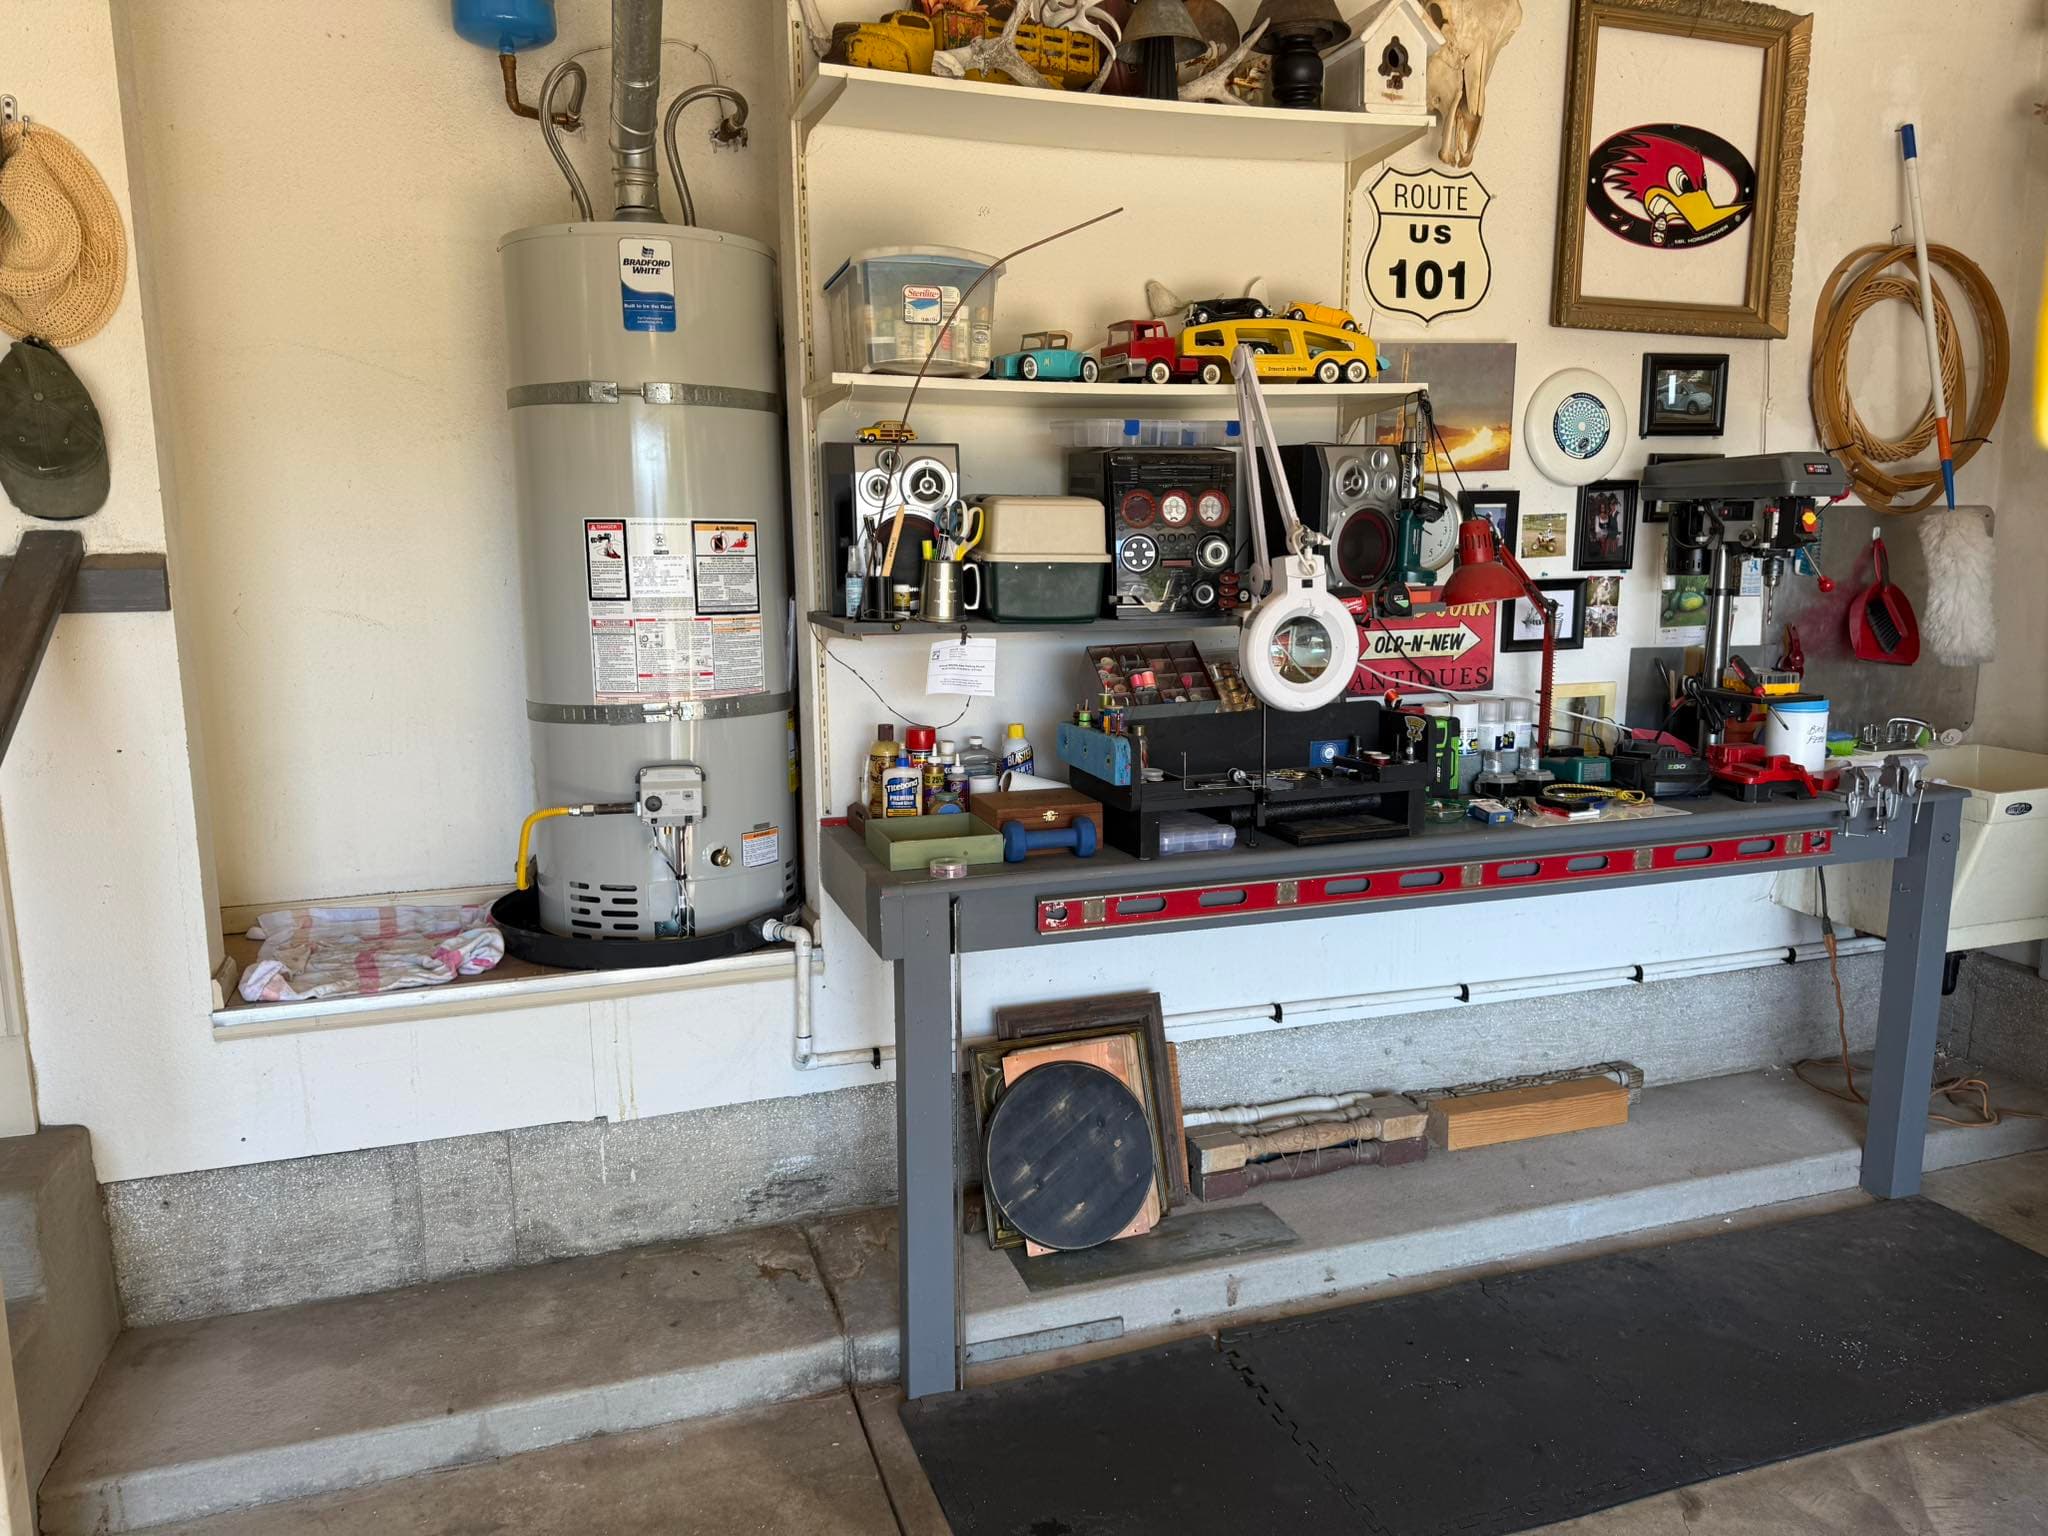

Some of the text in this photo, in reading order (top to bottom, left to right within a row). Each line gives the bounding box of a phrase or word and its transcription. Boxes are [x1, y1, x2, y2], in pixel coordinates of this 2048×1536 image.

[1394, 183, 1468, 211] ROUTE
[1409, 223, 1452, 244] US
[1687, 224, 1729, 244] HORSEPOWER
[622, 258, 671, 267] BRADFORD
[632, 266, 662, 275] WHITE
[1388, 259, 1466, 300] 101
[907, 288, 937, 298] Sterilite
[1374, 632, 1467, 654] OLD-N-NEW
[1351, 666, 1489, 692] ANTIQUES
[886, 779, 918, 793] Titebond
